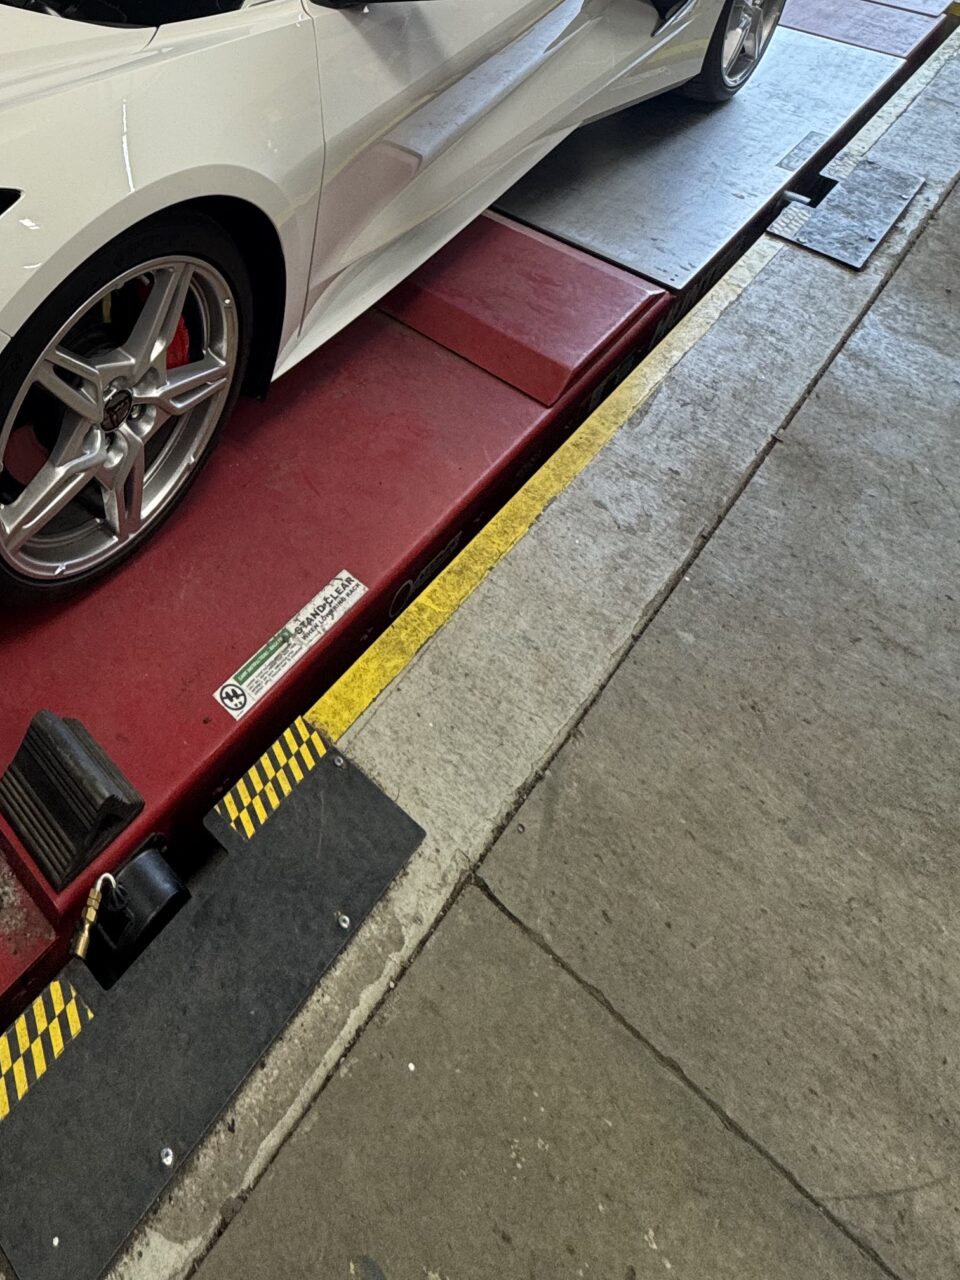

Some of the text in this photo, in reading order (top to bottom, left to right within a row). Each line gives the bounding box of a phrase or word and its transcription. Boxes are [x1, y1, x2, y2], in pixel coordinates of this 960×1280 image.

[294, 576, 355, 635] STAND CLEAR
[302, 623, 319, 640] WHEN
[346, 583, 361, 598] RACK
